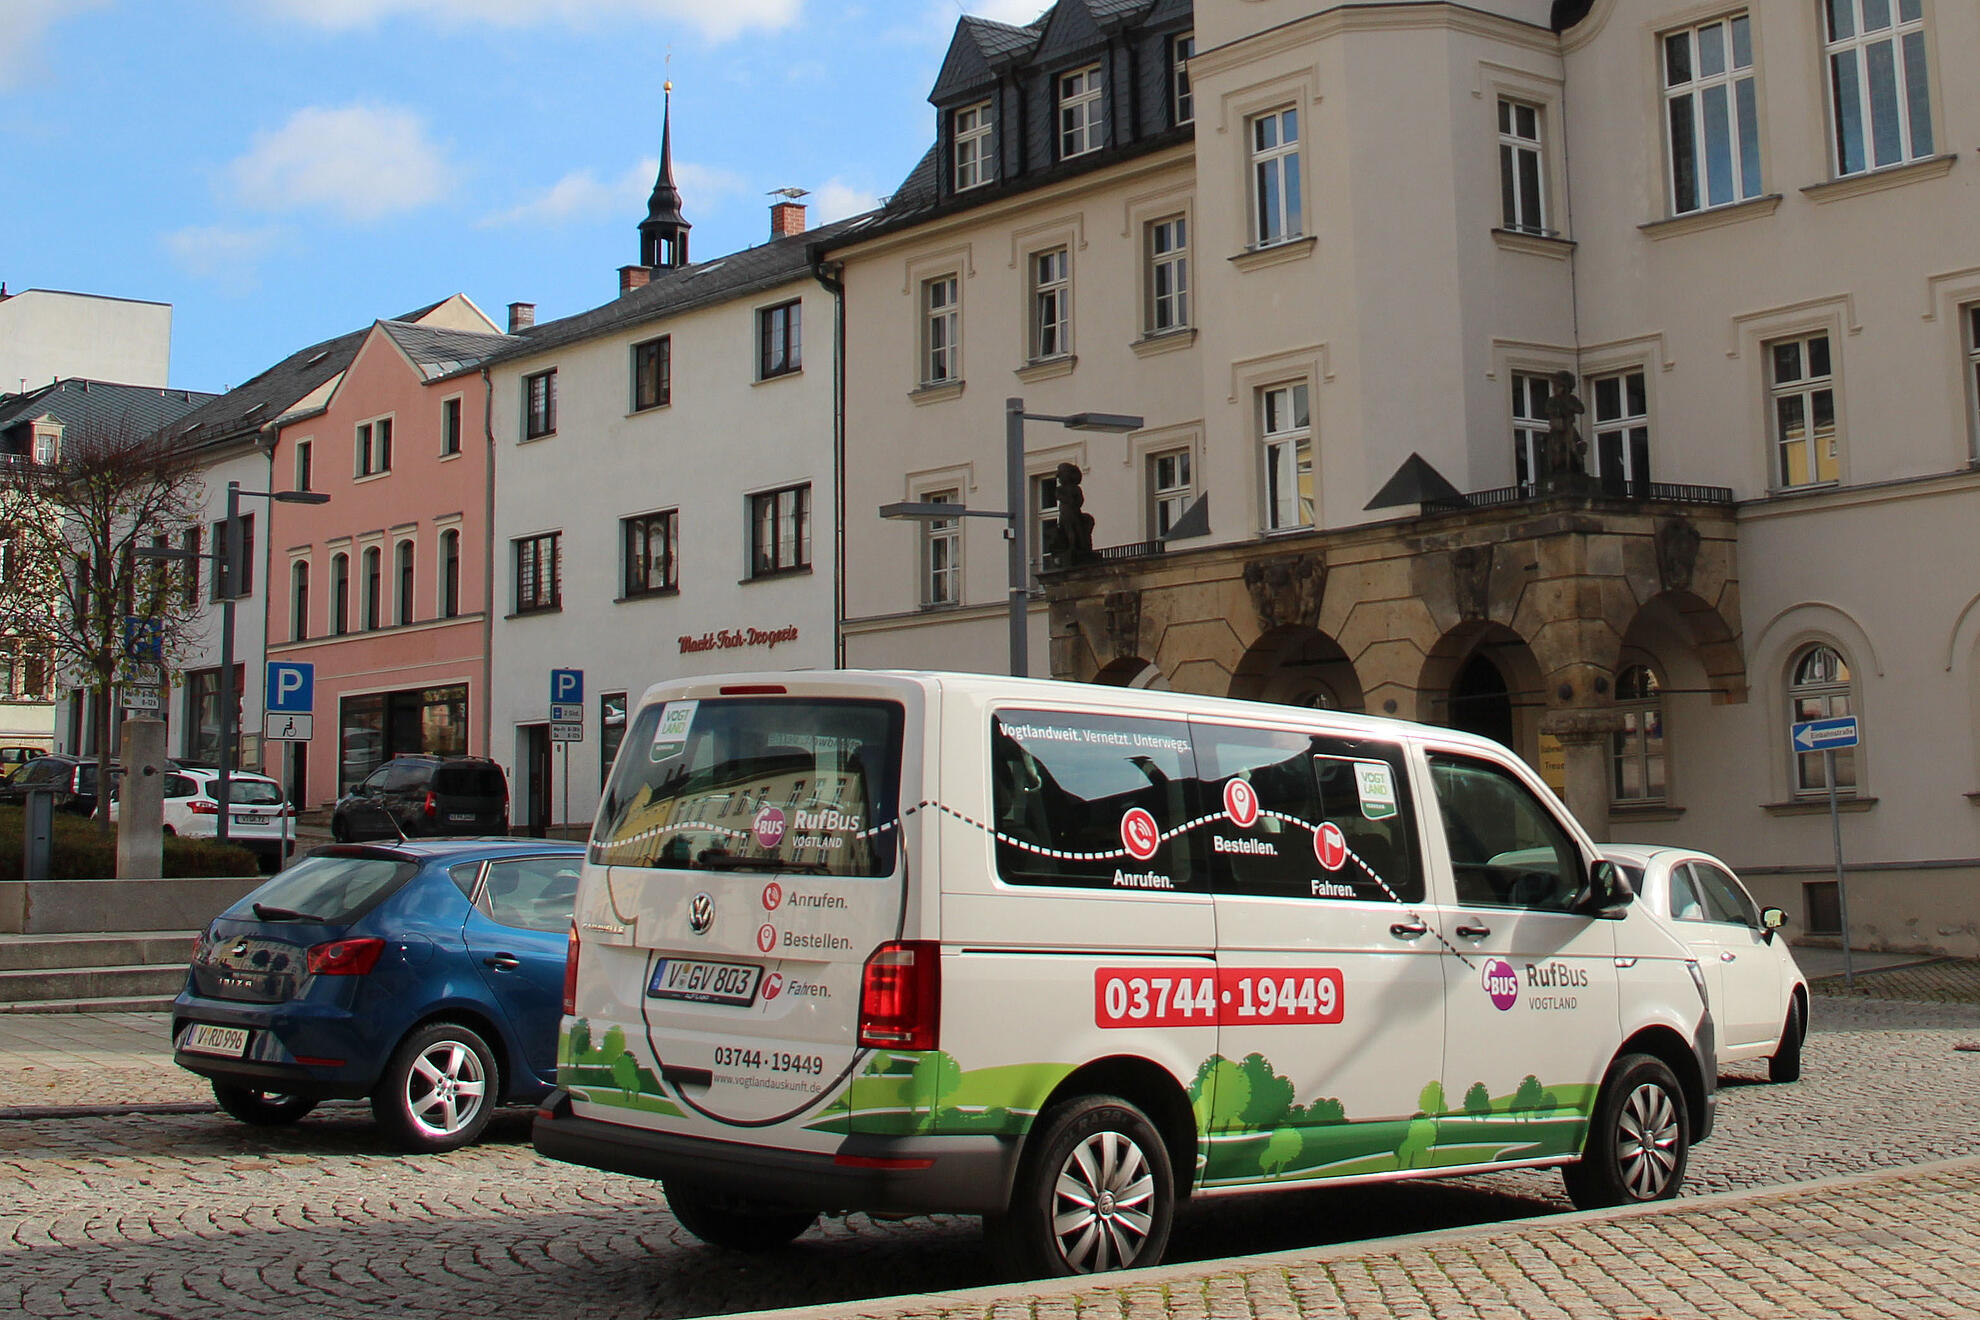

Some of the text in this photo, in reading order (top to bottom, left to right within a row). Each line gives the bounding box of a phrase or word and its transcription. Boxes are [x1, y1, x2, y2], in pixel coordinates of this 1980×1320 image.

[678, 624, 798, 653] Markt-Fach-Drogerie
[278, 669, 303, 704] P
[559, 674, 576, 698] P
[665, 709, 691, 722] VOGT
[661, 722, 686, 735] LAND
[999, 723, 1192, 752] Vogtlandweit. Vernetzt. Unterwegs.
[1361, 772, 1386, 783] VOGT
[1364, 783, 1388, 795] LAND
[760, 809, 860, 834] BUS RufBus
[793, 836, 842, 848] VOGTLAND
[1213, 836, 1278, 855] Bestellen.
[1113, 869, 1174, 888] Anrufen.
[1311, 879, 1356, 897] Fahren.
[788, 891, 848, 909] Anrufen.
[783, 931, 853, 950] Bestellen.
[713, 967, 752, 994] 803
[1491, 962, 1588, 995] BUS RufBus
[787, 980, 832, 997] Fahren.
[1529, 997, 1577, 1010] VOGTLAND
[714, 1073, 822, 1093] www.vogtlandauskunft.de
